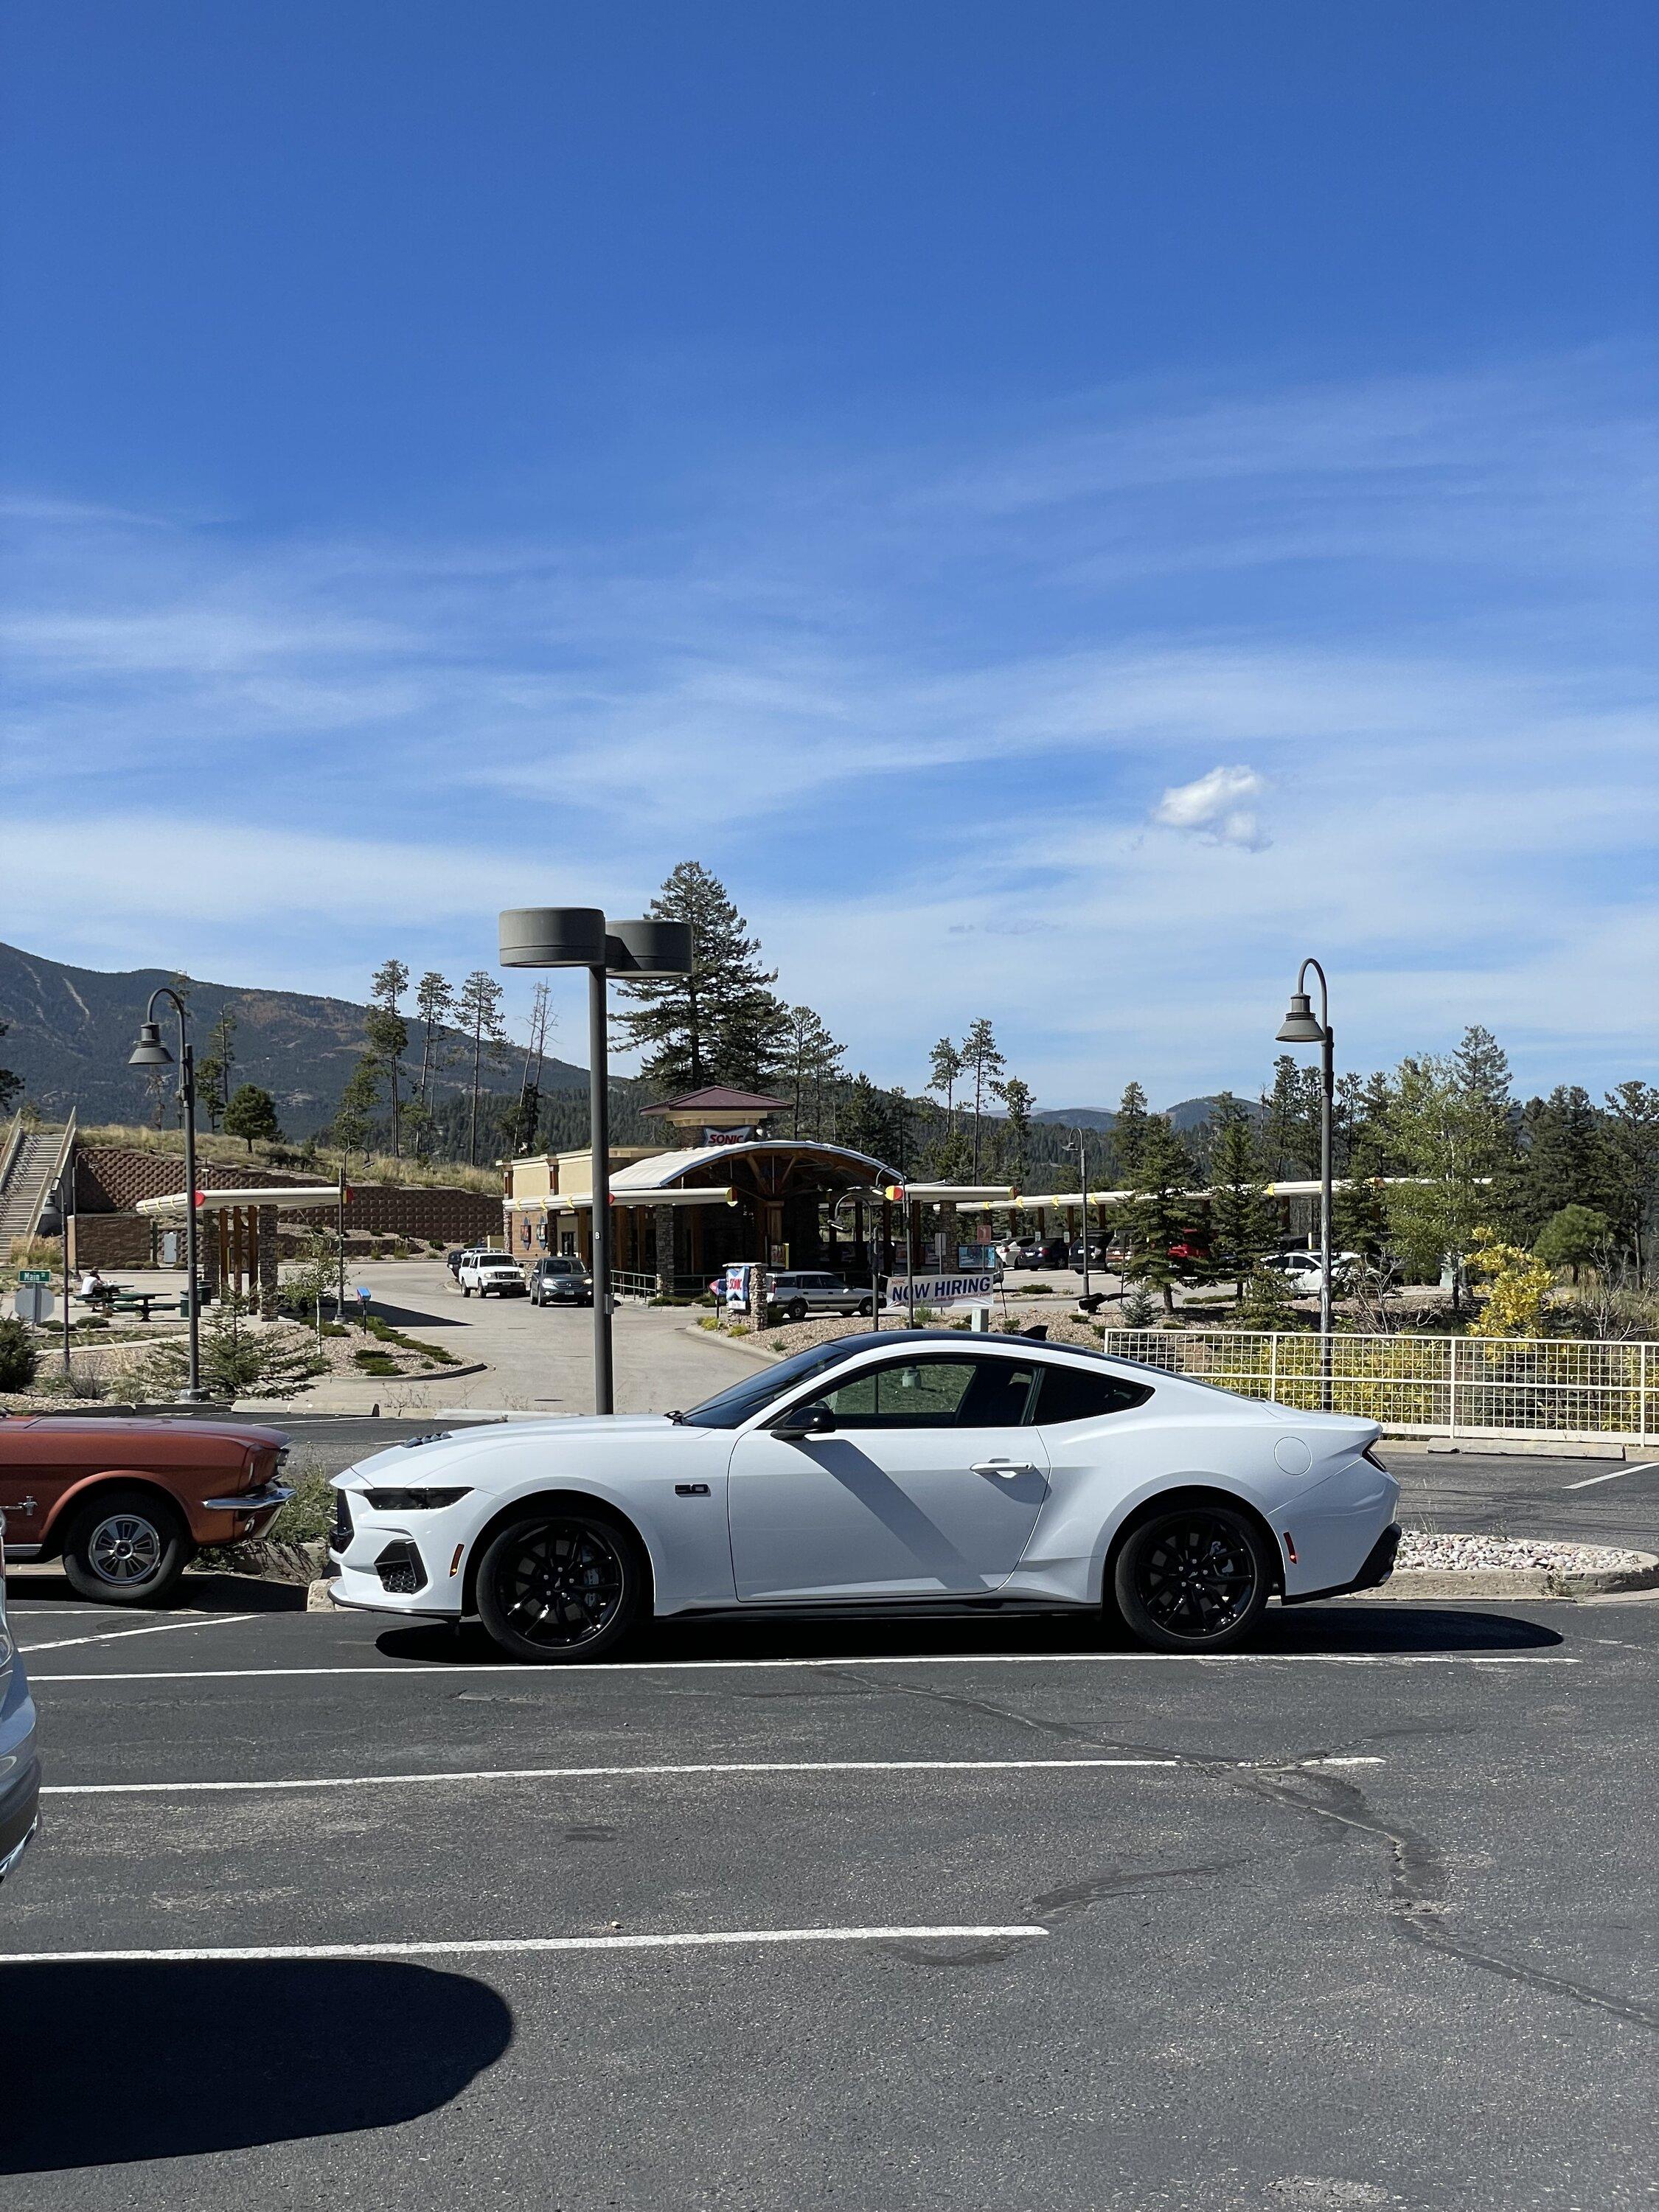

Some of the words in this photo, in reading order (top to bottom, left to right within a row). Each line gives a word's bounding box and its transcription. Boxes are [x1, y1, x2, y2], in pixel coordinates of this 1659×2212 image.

[709, 1134, 743, 1144] SONIC
[595, 1231, 600, 1239] B
[24, 1272, 40, 1281] Main
[934, 1276, 990, 1297] HIRING
